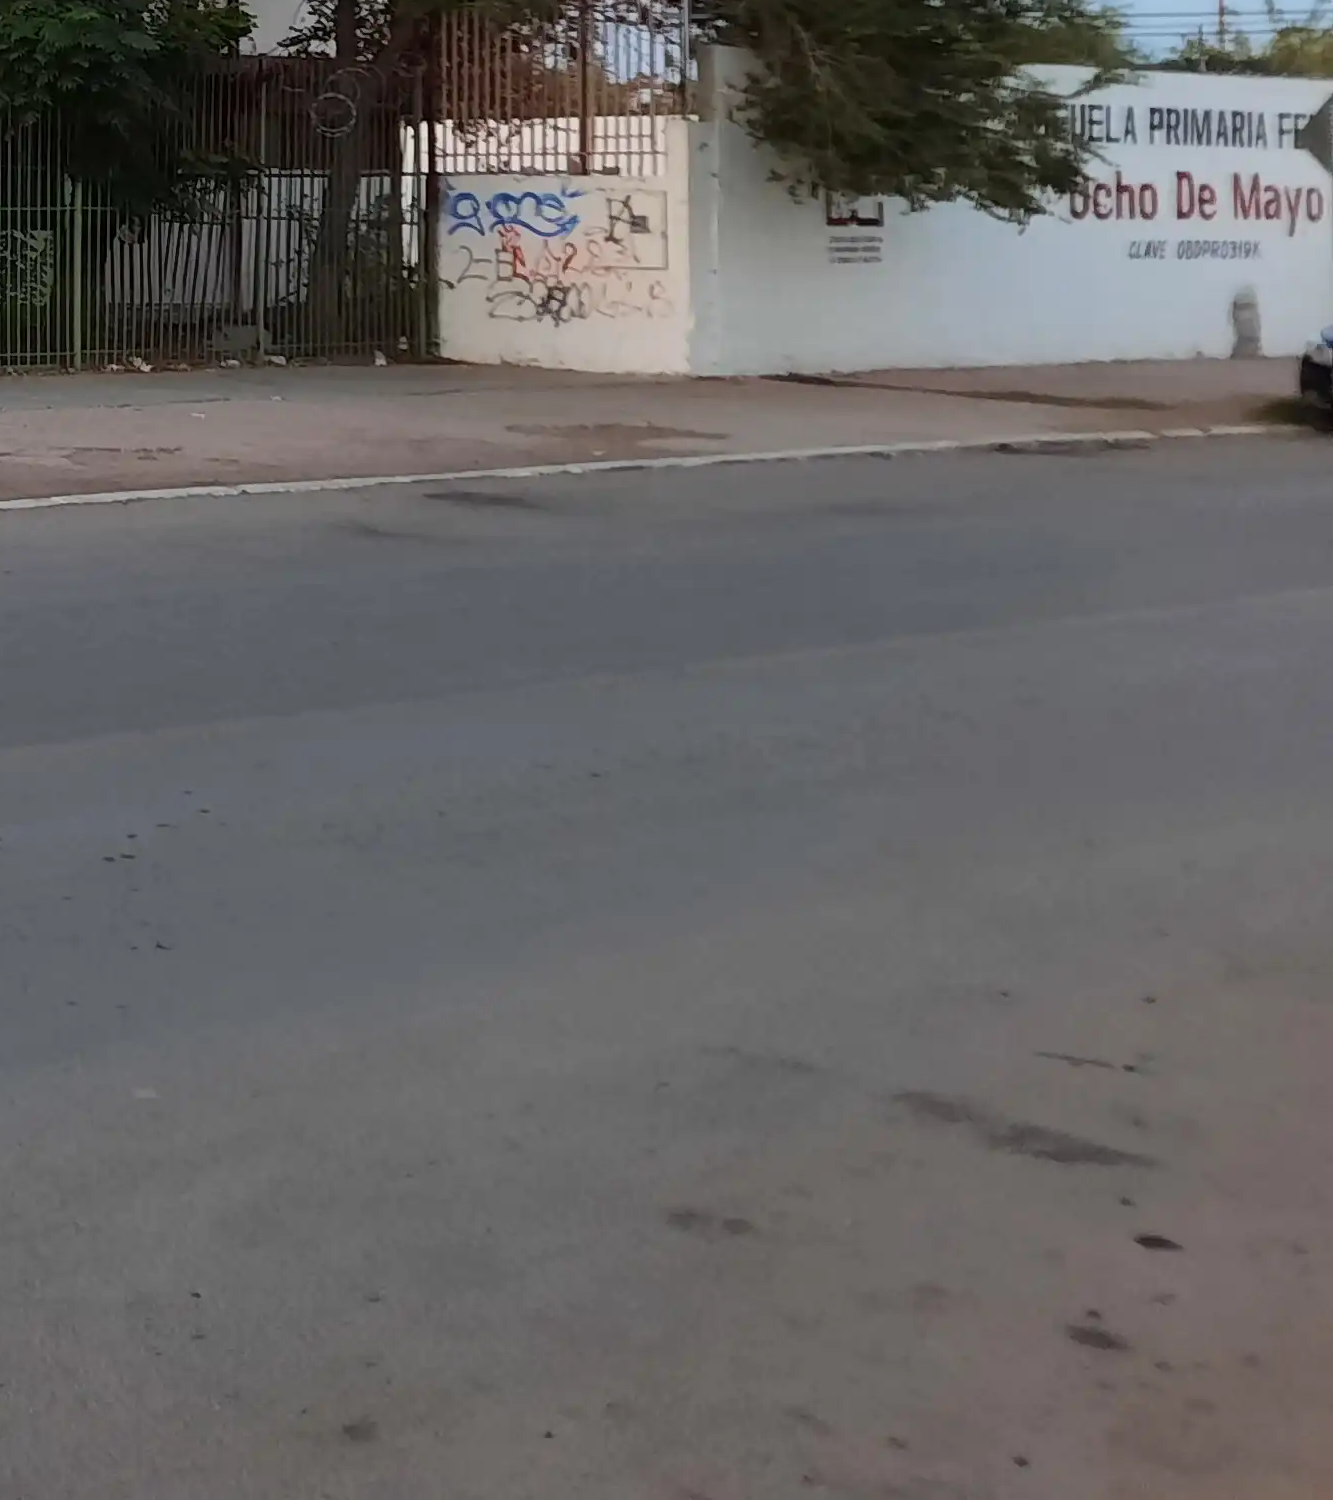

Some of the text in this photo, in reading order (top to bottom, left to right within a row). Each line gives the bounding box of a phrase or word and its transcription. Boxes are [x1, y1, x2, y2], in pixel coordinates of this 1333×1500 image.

[1065, 104, 1137, 144] UELA
[1149, 107, 1268, 149] PRIMARIA
[1176, 170, 1217, 221] De
[1233, 172, 1324, 237] Mayo
[1127, 240, 1166, 260] CLAVE
